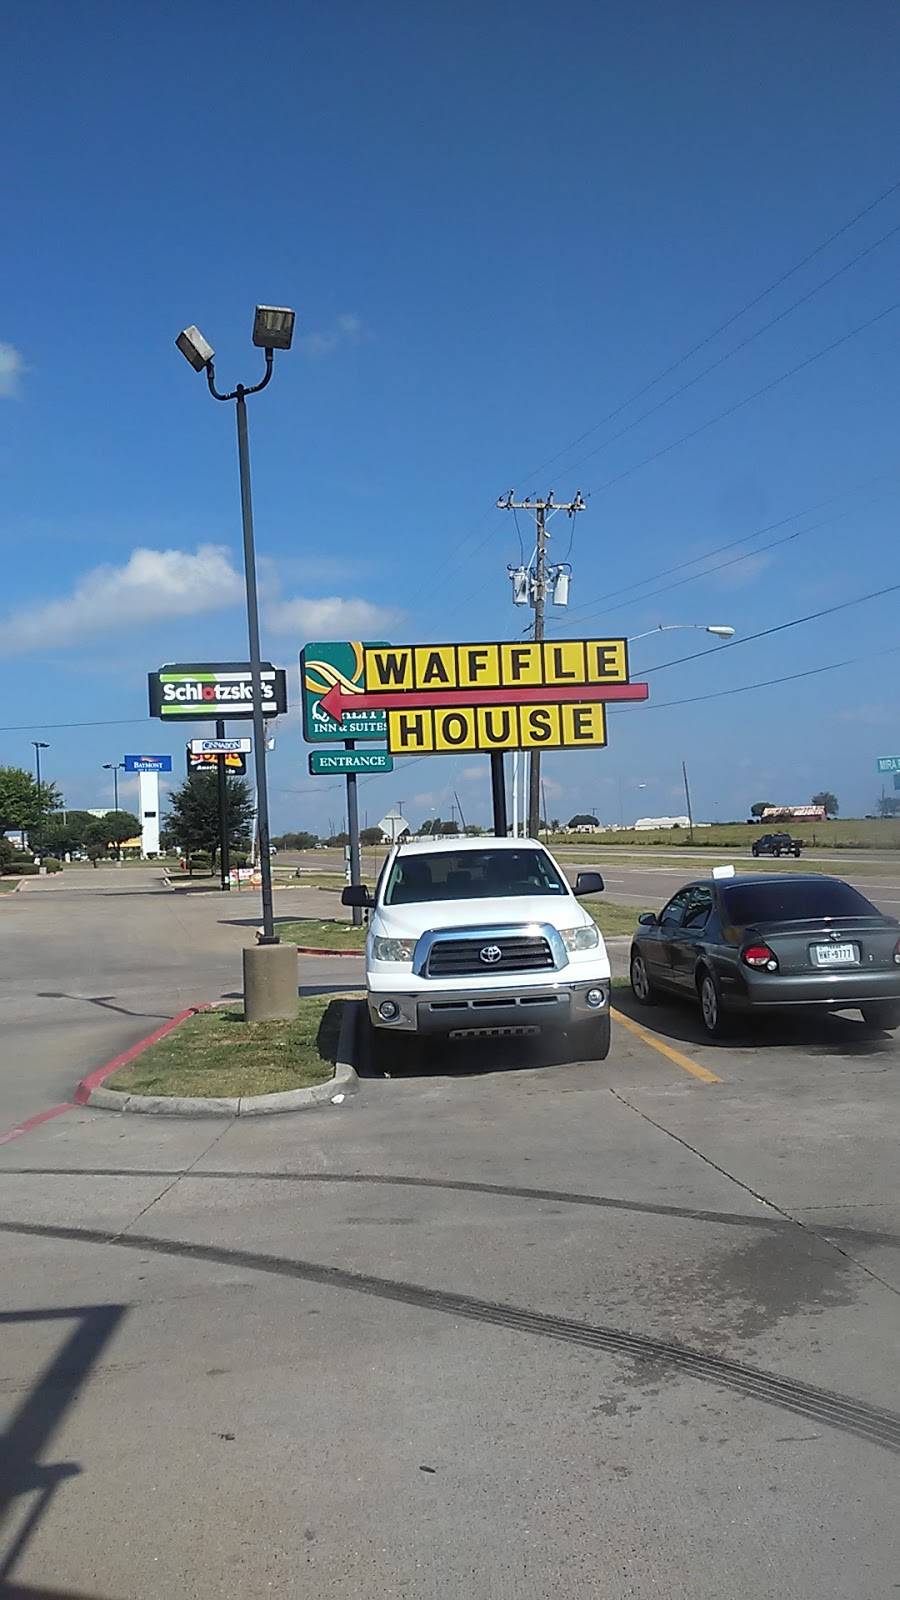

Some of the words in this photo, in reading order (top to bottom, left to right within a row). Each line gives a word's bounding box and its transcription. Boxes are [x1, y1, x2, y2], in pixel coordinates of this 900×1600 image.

[374, 646, 617, 685] WAFFLE
[314, 723, 337, 733] INN
[399, 708, 594, 747] HOUSE
[319, 756, 386, 767] ENTRANCE
